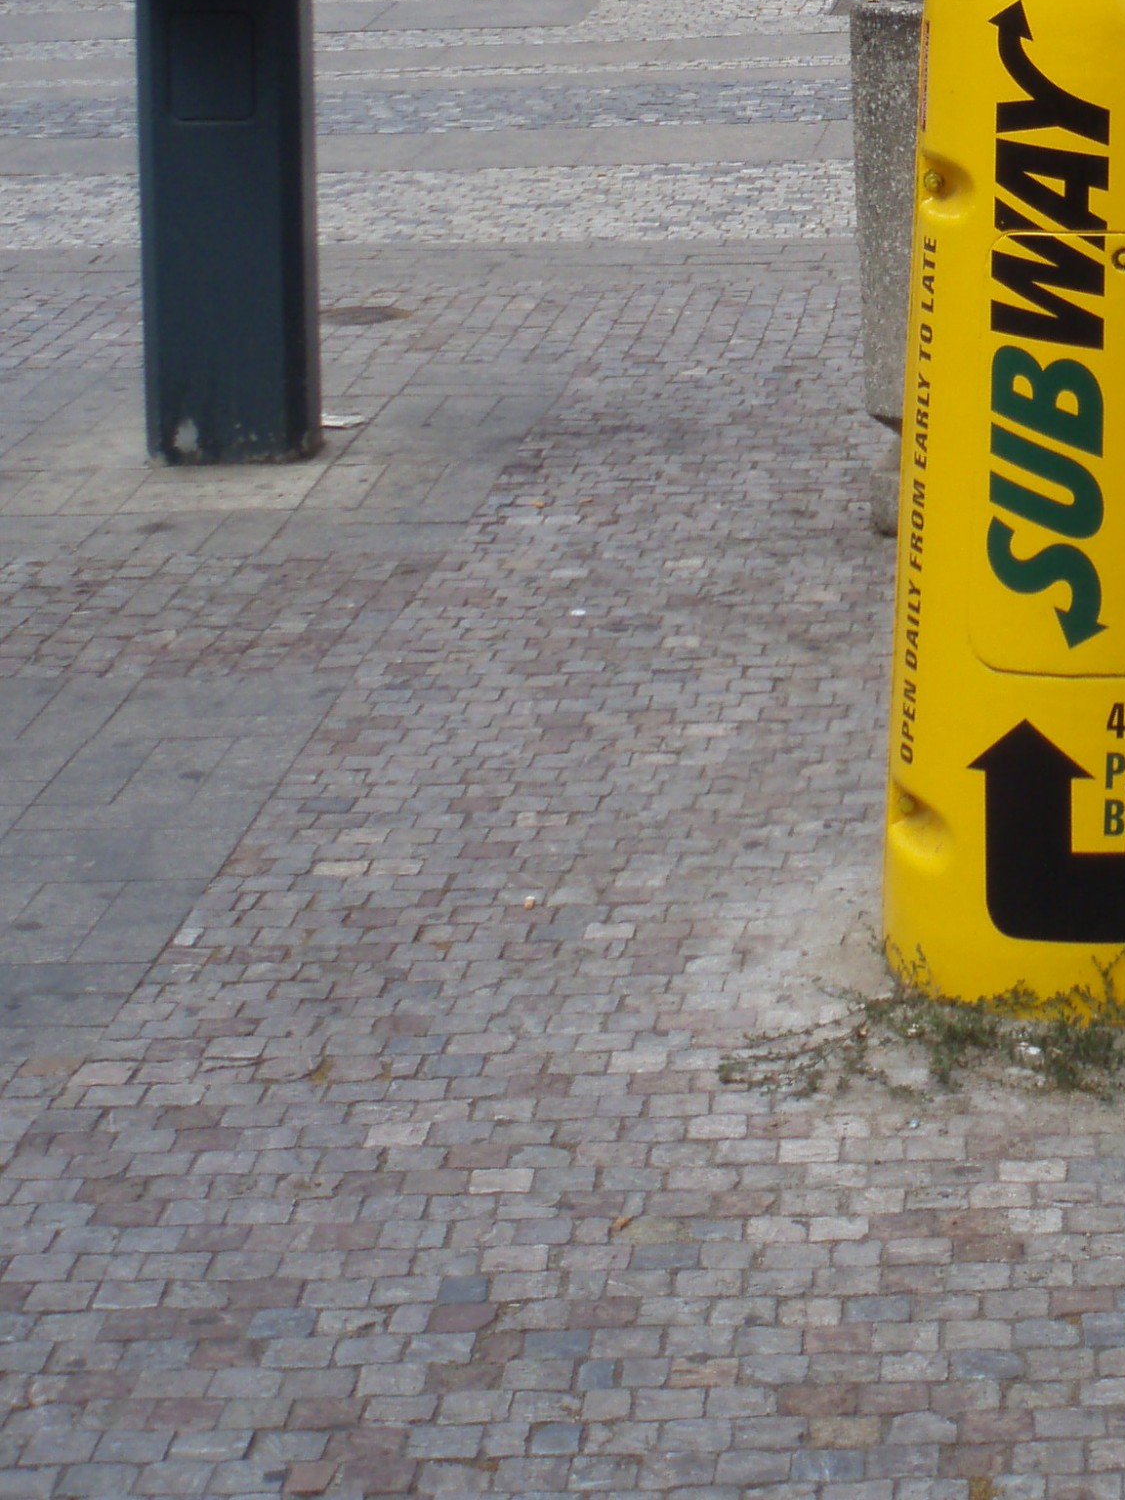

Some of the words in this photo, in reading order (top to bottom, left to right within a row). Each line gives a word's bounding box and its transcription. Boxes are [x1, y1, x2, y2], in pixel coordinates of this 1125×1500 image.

[921, 235, 938, 315] LATE
[919, 321, 934, 363] TO
[986, 0, 1111, 650] SUBWAY
[914, 371, 932, 472] EARLY
[909, 478, 927, 573] FROM
[904, 579, 922, 672] DAILY
[900, 678, 917, 765] OPEN
